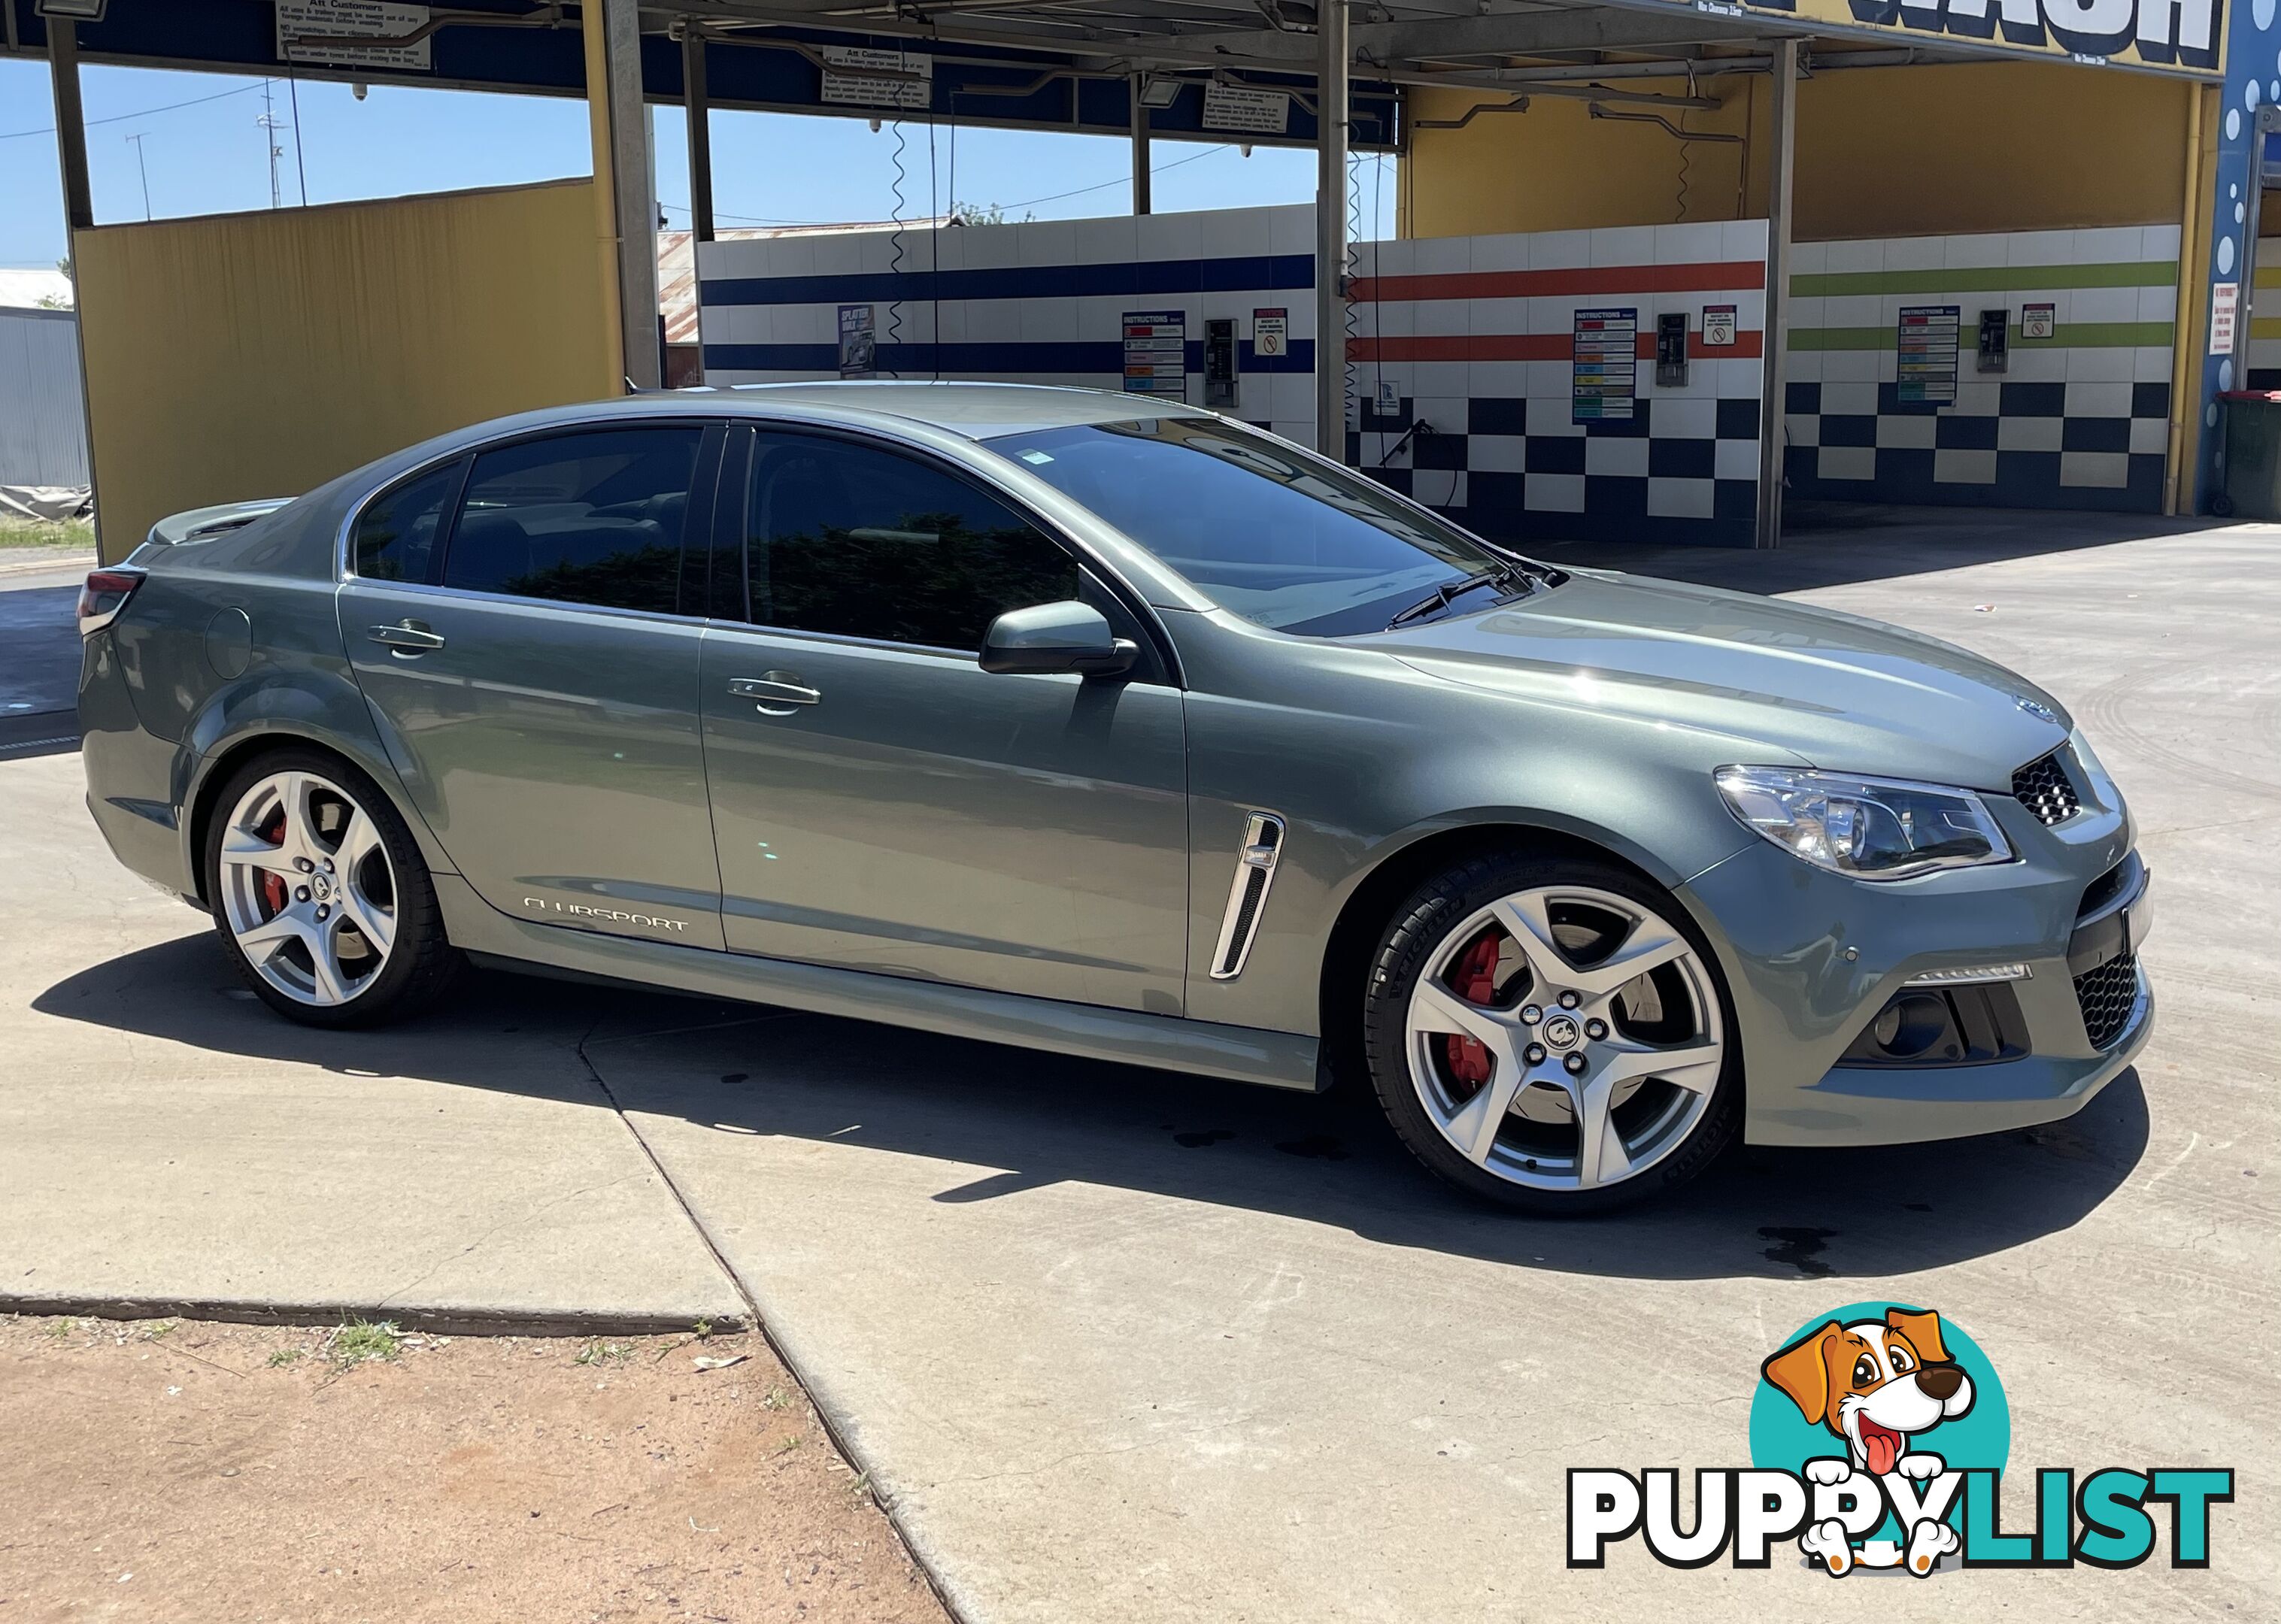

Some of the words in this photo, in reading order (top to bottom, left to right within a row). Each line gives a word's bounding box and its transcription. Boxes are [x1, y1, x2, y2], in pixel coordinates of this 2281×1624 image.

[331, 0, 383, 11] Customers
[842, 308, 869, 320] SPLATTER
[524, 897, 688, 932] CLUBSPORT
[1400, 897, 1463, 976] MICHELIN
